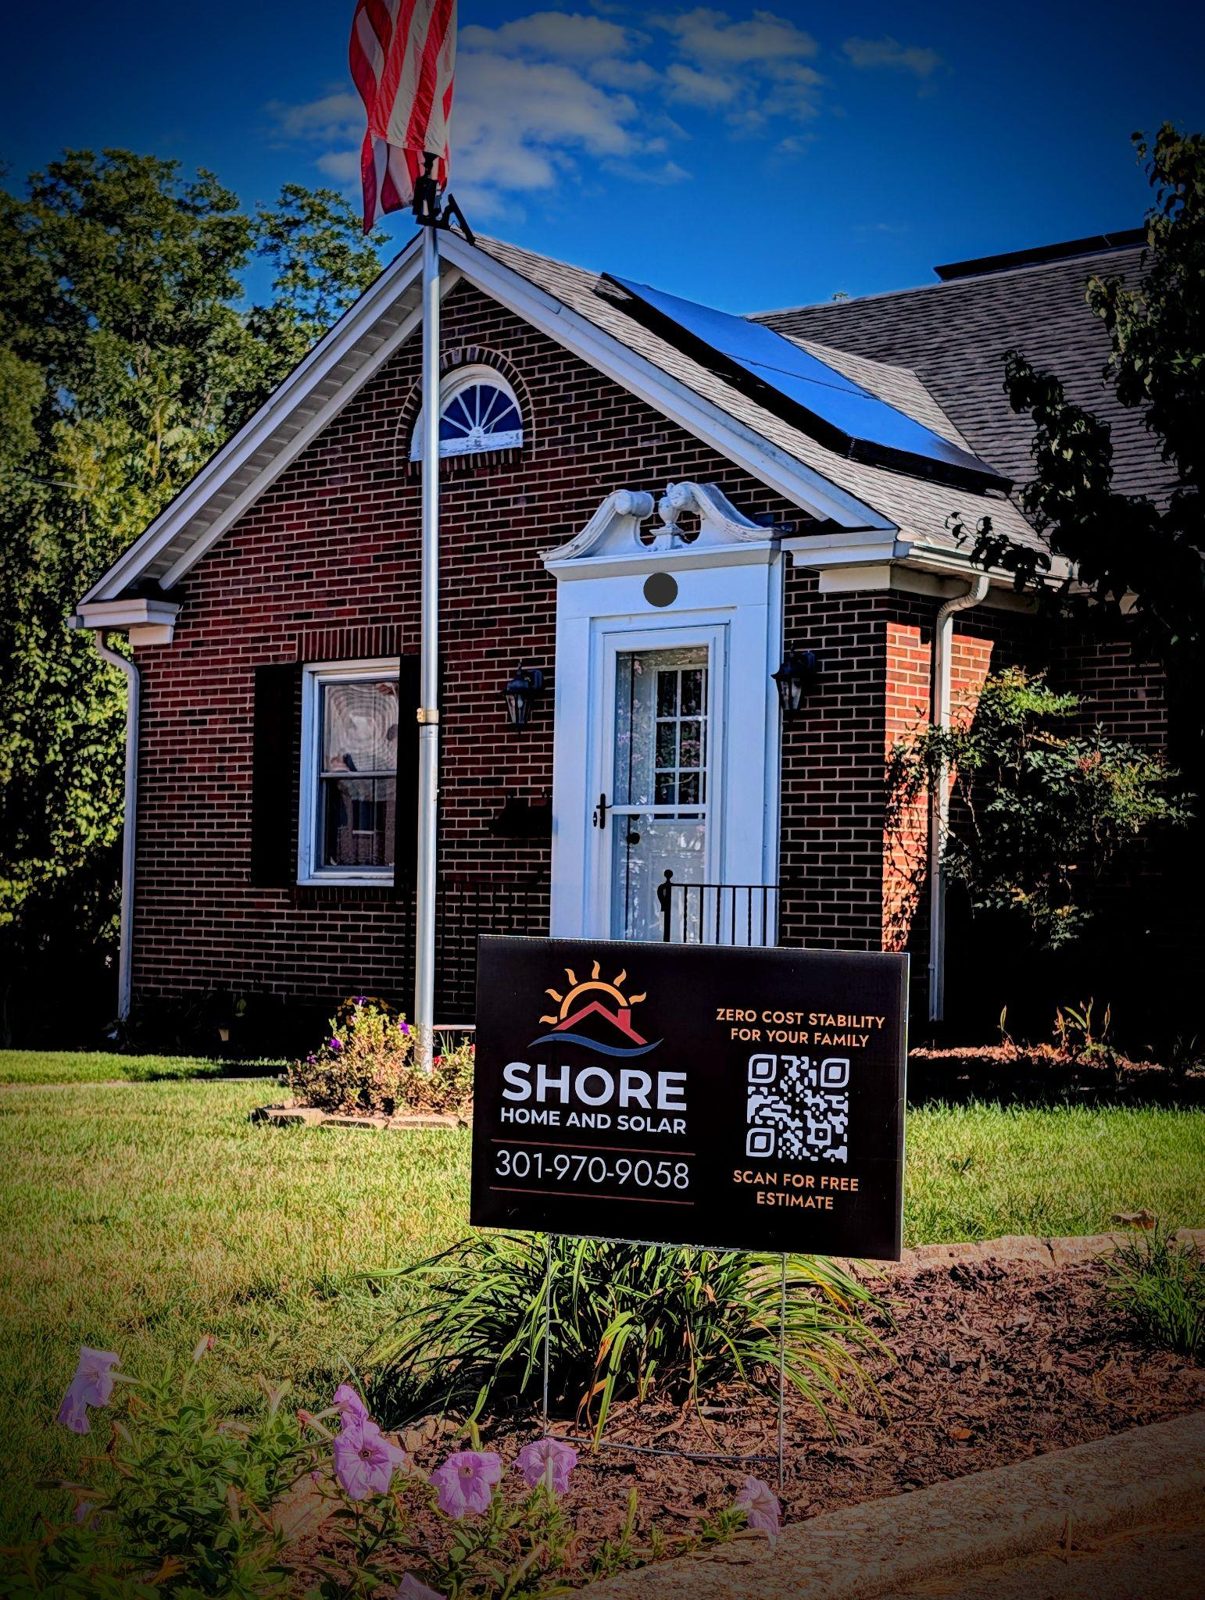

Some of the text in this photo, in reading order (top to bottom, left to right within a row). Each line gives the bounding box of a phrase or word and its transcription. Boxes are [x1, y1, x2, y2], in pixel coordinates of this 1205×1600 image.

[716, 1009, 885, 1028] ZERO COST STABILITY
[731, 1028, 869, 1047] FOR YOUR FAMILY
[502, 1062, 686, 1110] SHORE
[501, 1107, 686, 1134] HOME AND SOLAR
[495, 1150, 690, 1190] 301-970-9058
[734, 1170, 858, 1191] SCAN FOR FREE
[757, 1192, 833, 1209] ESTIMATE
